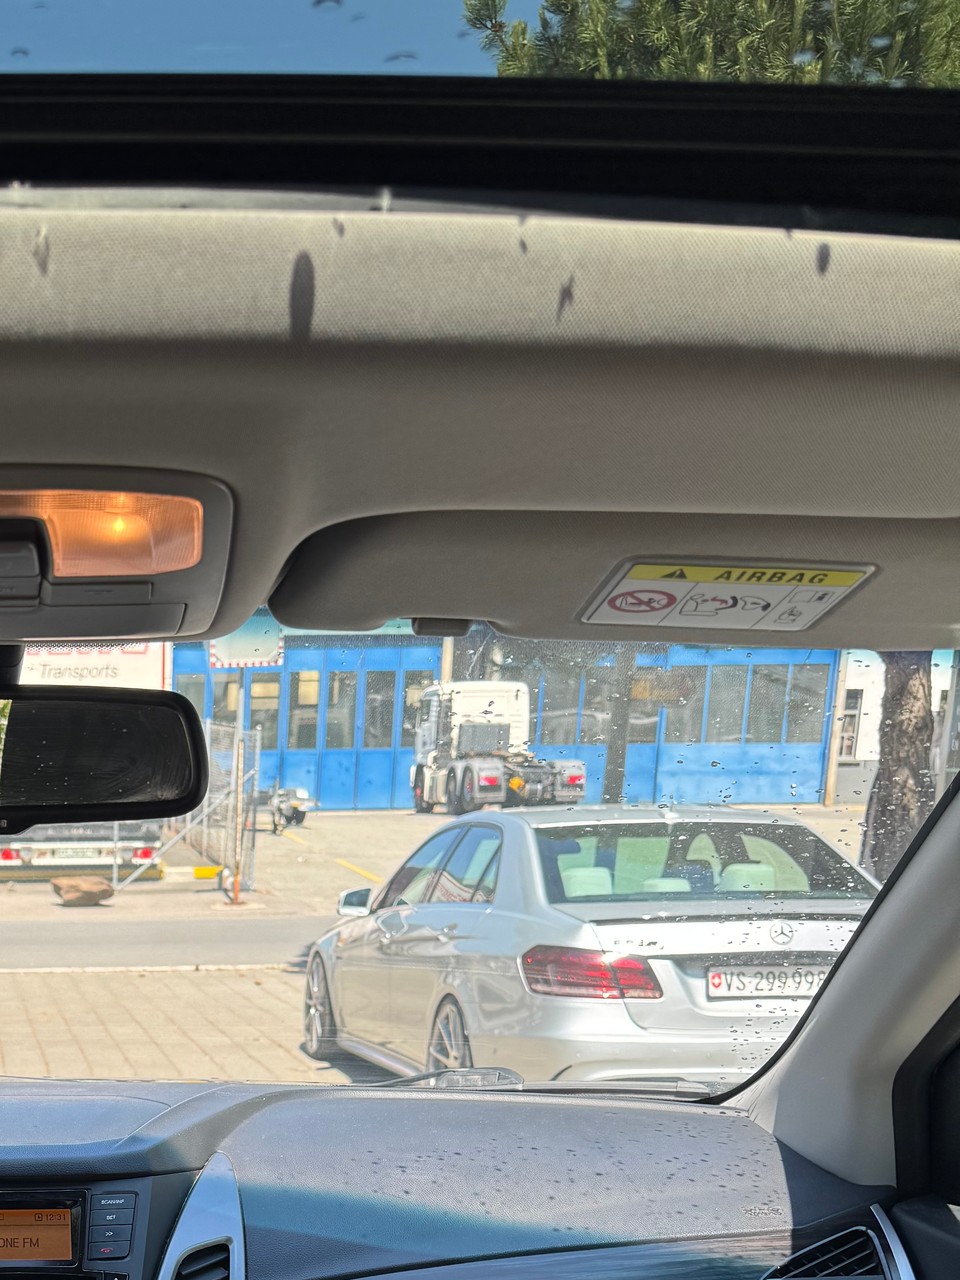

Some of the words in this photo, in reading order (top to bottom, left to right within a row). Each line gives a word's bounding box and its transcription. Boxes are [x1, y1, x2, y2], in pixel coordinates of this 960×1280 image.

[713, 569, 829, 585] AIRBAG
[40, 663, 119, 681] Transports
[724, 972, 746, 991] VS
[45, 1213, 66, 1221] 12:31
[22, 1237, 40, 1248] FM
